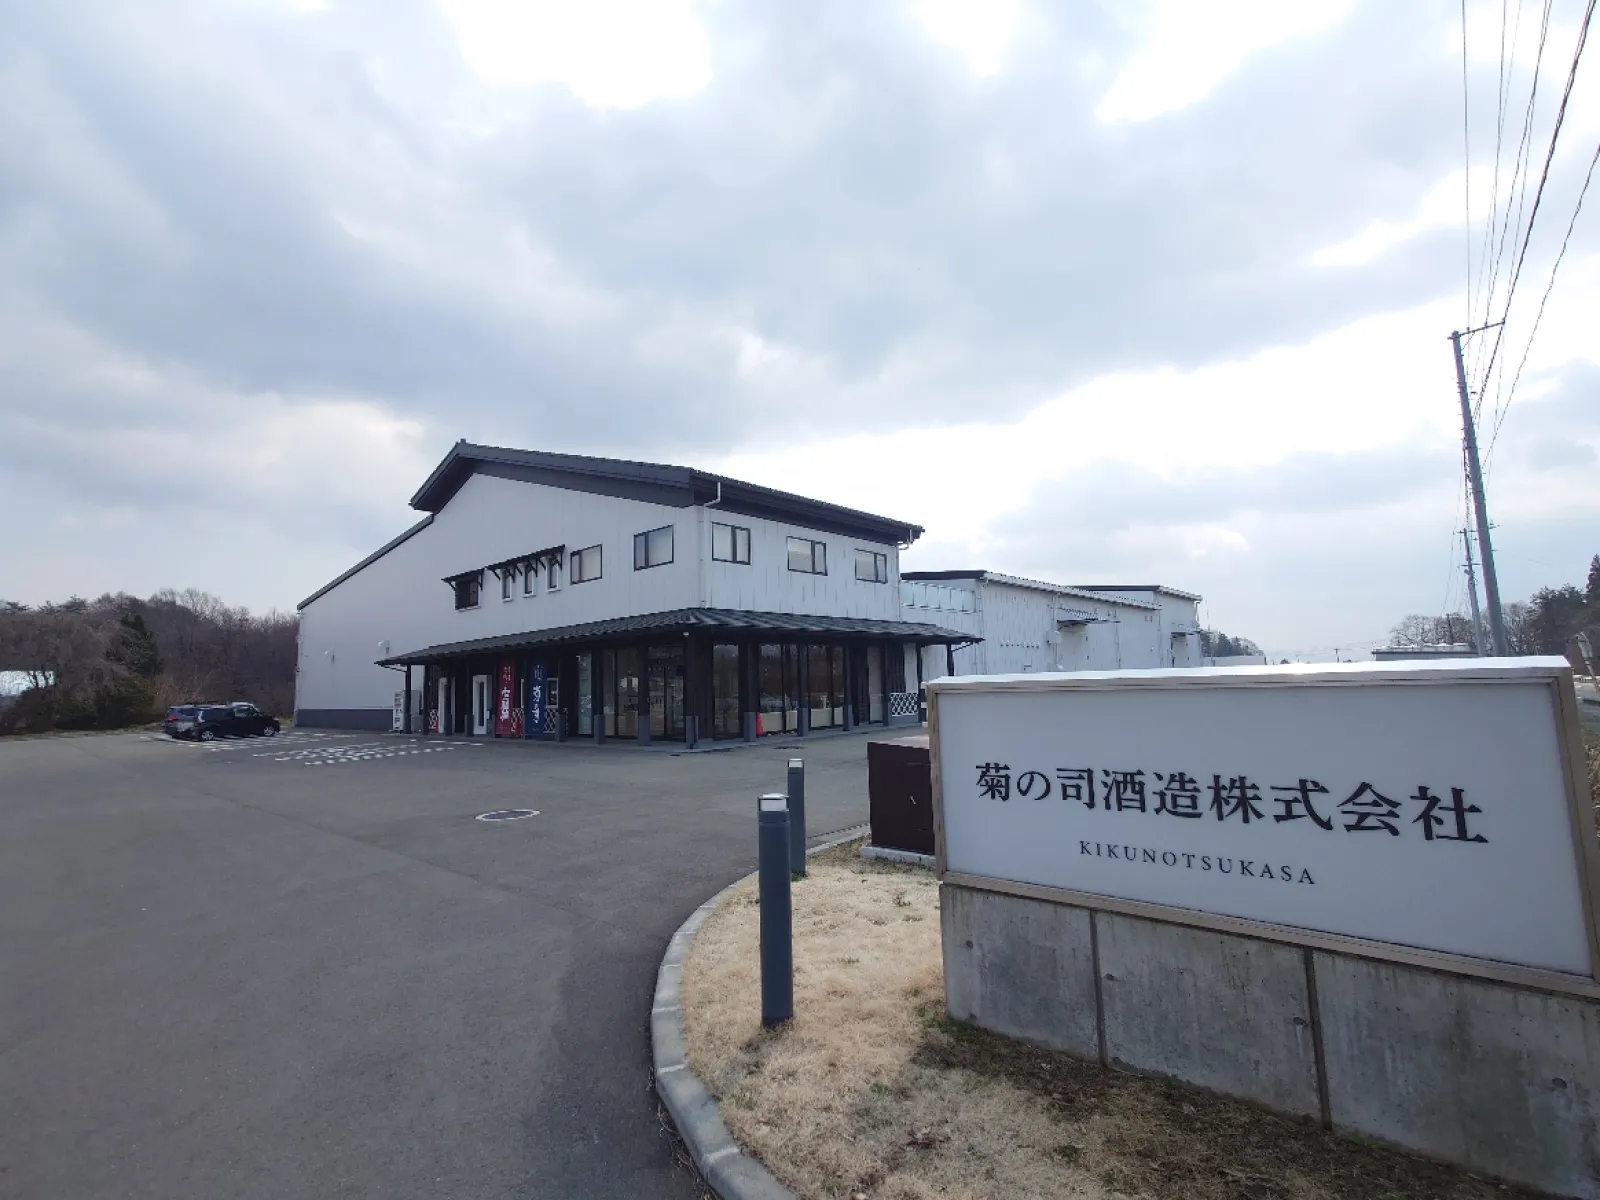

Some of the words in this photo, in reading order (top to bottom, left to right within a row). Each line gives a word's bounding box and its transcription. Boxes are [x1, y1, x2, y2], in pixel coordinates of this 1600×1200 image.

[975, 763, 1489, 844] 菊の司酒造株式会社
[1080, 840, 1316, 885] KIKUNOTSUKASA
